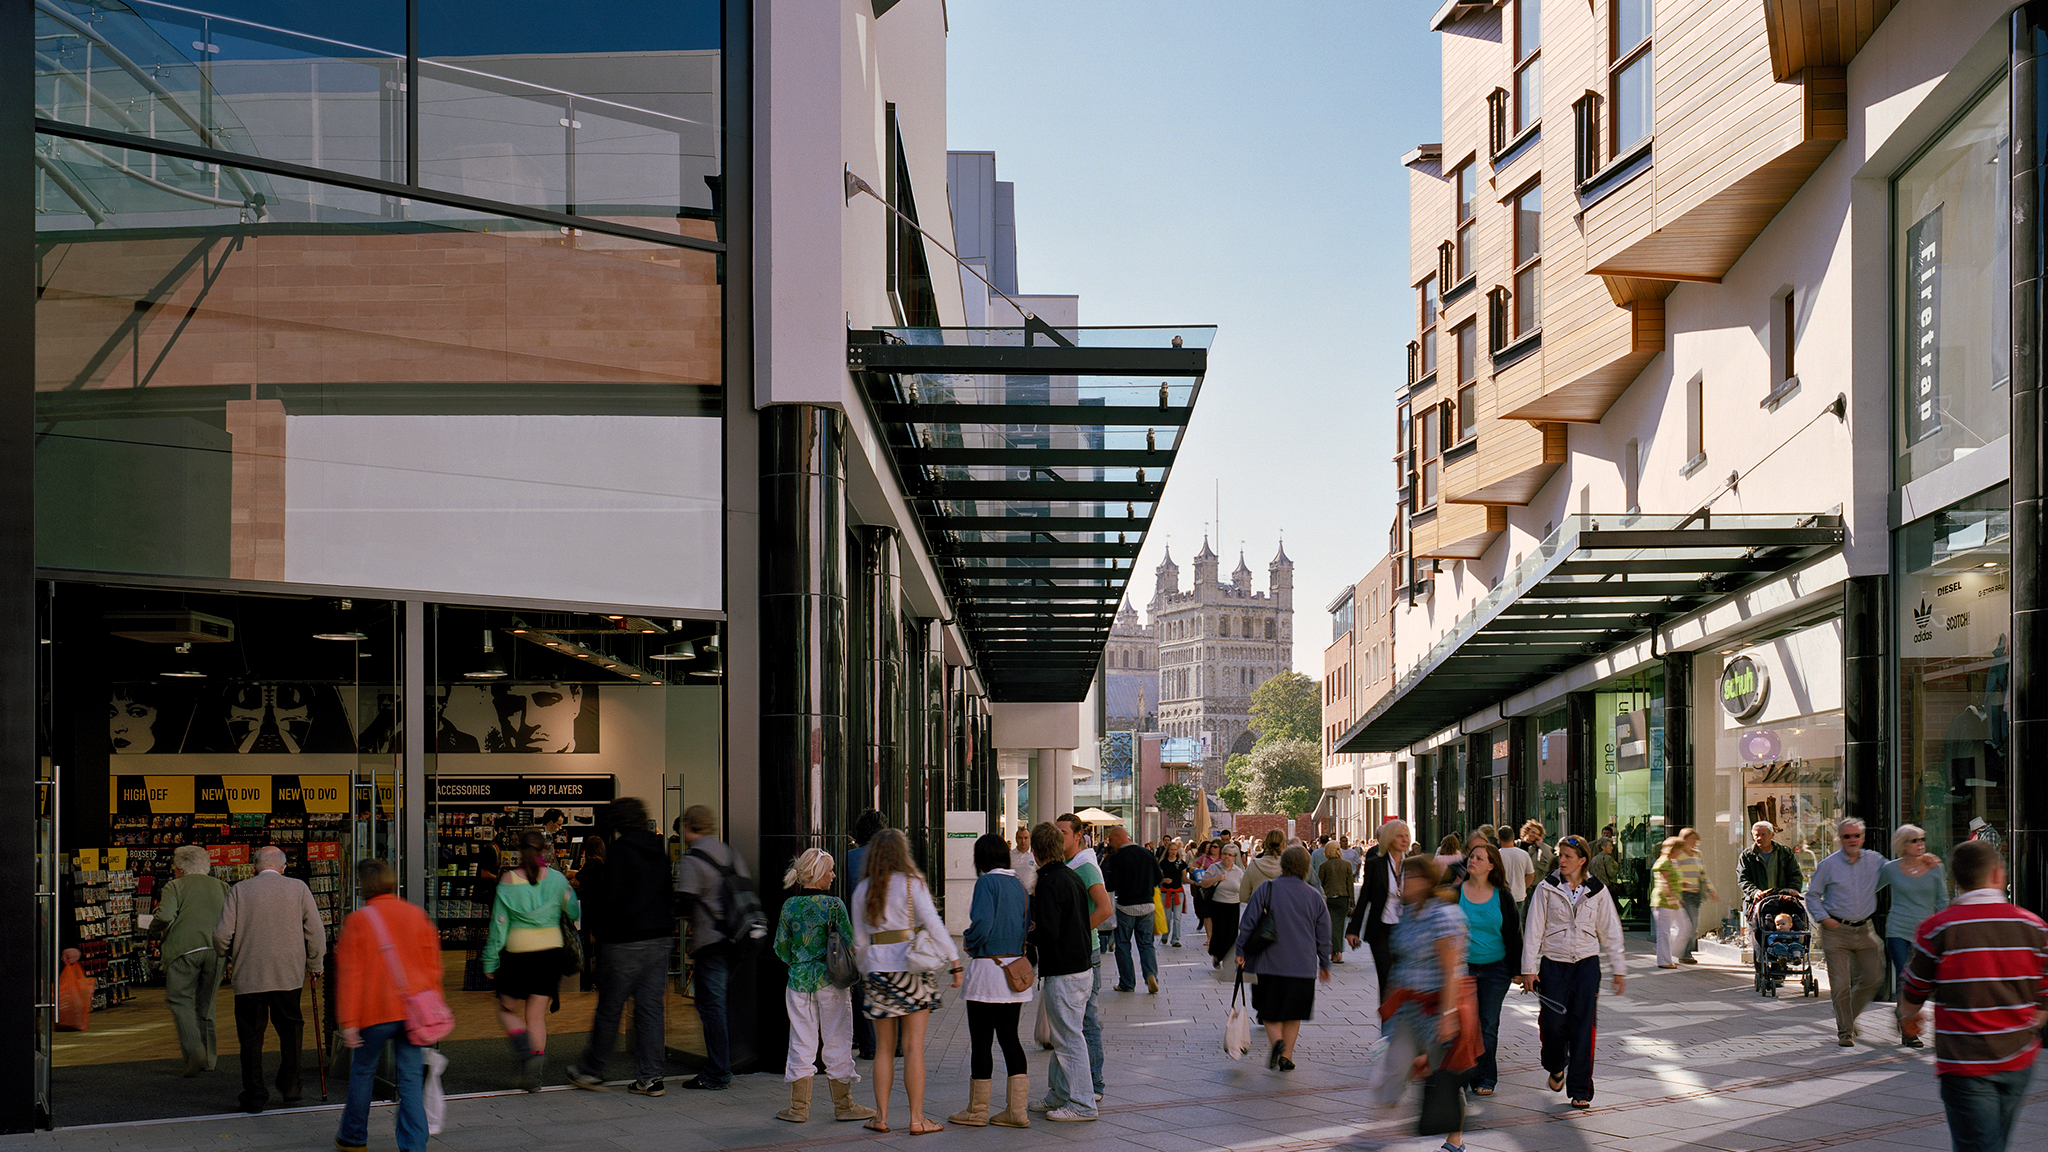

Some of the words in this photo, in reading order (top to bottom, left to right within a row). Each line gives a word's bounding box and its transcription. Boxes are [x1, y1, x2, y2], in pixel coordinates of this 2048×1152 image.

[1919, 241, 1936, 421] Firetrap
[1937, 581, 1962, 597] DIESEL
[1913, 630, 1933, 644] adidas
[1724, 666, 1754, 701] schuh
[1604, 743, 1622, 780] jane
[123, 789, 146, 800] HIGH
[150, 789, 168, 800] DEF
[202, 788, 223, 800] NEW
[226, 788, 238, 800] TO
[241, 788, 260, 800] DVD
[278, 788, 300, 800] NEW
[303, 788, 315, 800] TO
[318, 788, 337, 800] DVD
[380, 788, 392, 800] TO
[436, 785, 491, 796] ACCESSORIES
[529, 784, 546, 795] MP3
[548, 784, 583, 795] PLAYERS
[129, 849, 157, 860] BOXSETS
